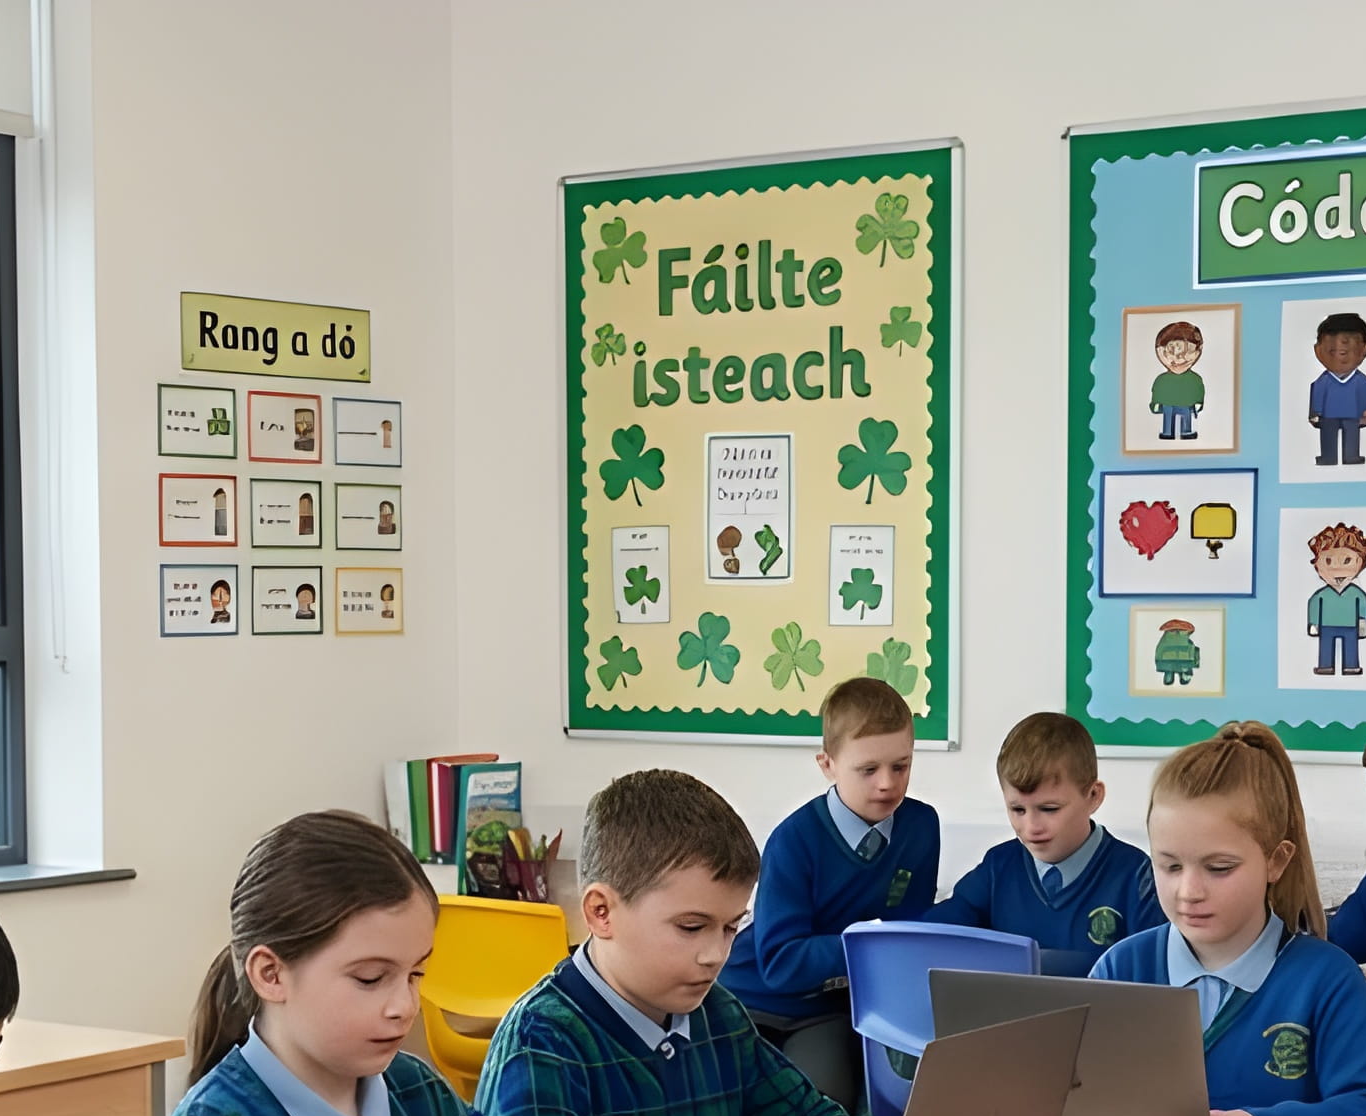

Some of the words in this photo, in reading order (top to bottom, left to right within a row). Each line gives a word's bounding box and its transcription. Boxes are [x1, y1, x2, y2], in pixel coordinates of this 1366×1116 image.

[657, 239, 843, 316] Fáilte
[198, 310, 278, 365] Rang
[291, 331, 309, 356] a
[321, 322, 355, 360] dó
[633, 326, 872, 407] isteach
